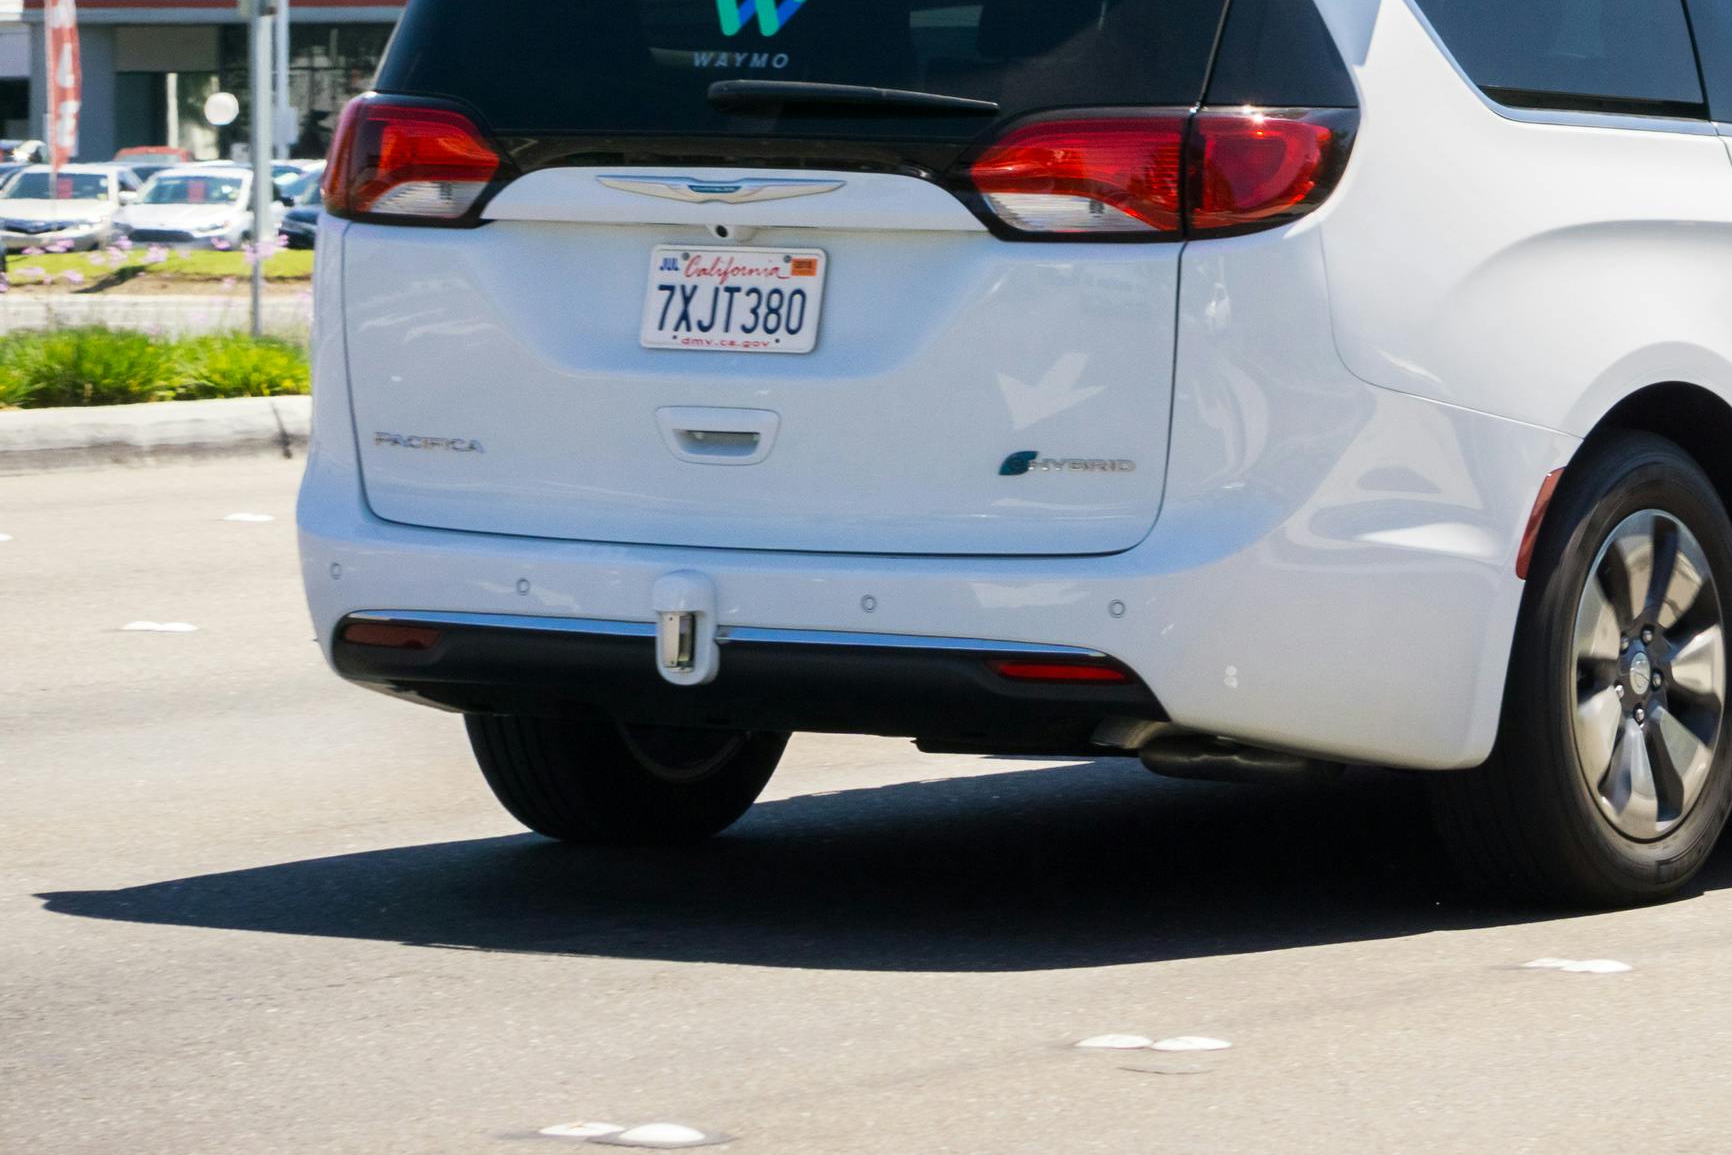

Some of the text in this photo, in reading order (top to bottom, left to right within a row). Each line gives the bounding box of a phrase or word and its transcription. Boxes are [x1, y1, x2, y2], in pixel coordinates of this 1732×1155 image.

[693, 52, 789, 68] WAYMO
[684, 255, 790, 285] California
[657, 284, 807, 335] 7XJT380
[373, 431, 487, 454] PACIFICA
